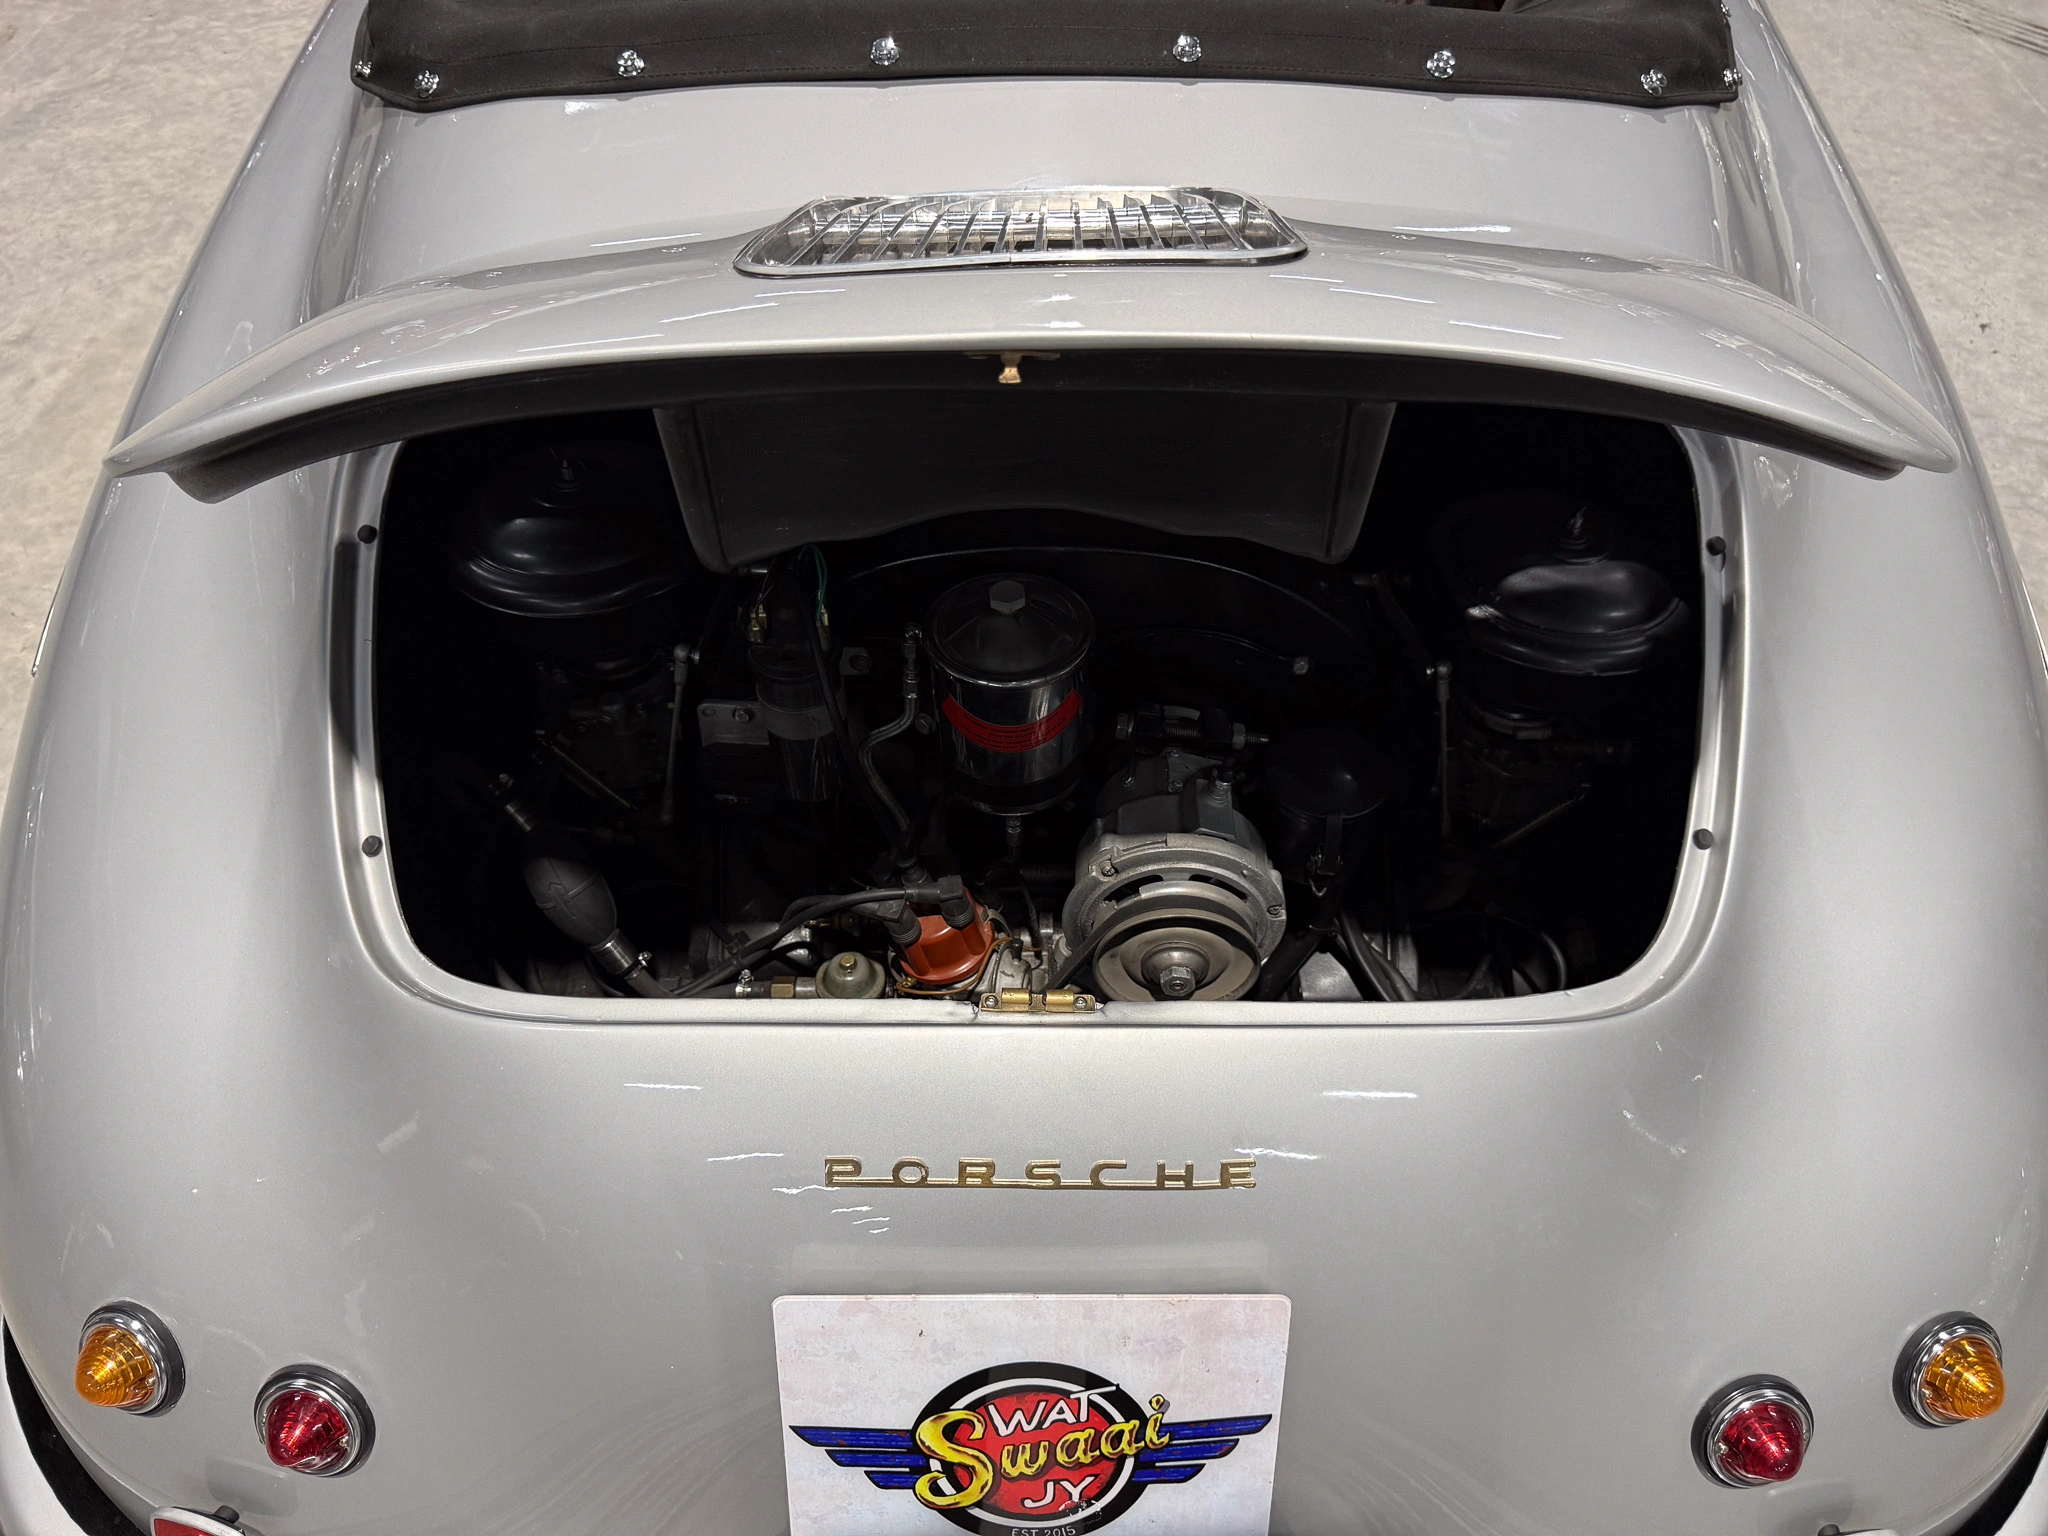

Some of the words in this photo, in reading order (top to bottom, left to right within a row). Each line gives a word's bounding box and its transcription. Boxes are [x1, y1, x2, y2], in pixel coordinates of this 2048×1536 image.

[825, 1156, 1256, 1189] PORSCHE
[988, 1386, 1117, 1437] WAT
[913, 1394, 1173, 1509] Swaai
[1023, 1476, 1096, 1508] JY
[1011, 1528, 1039, 1536] EST
[1044, 1526, 1076, 1536] 2015
